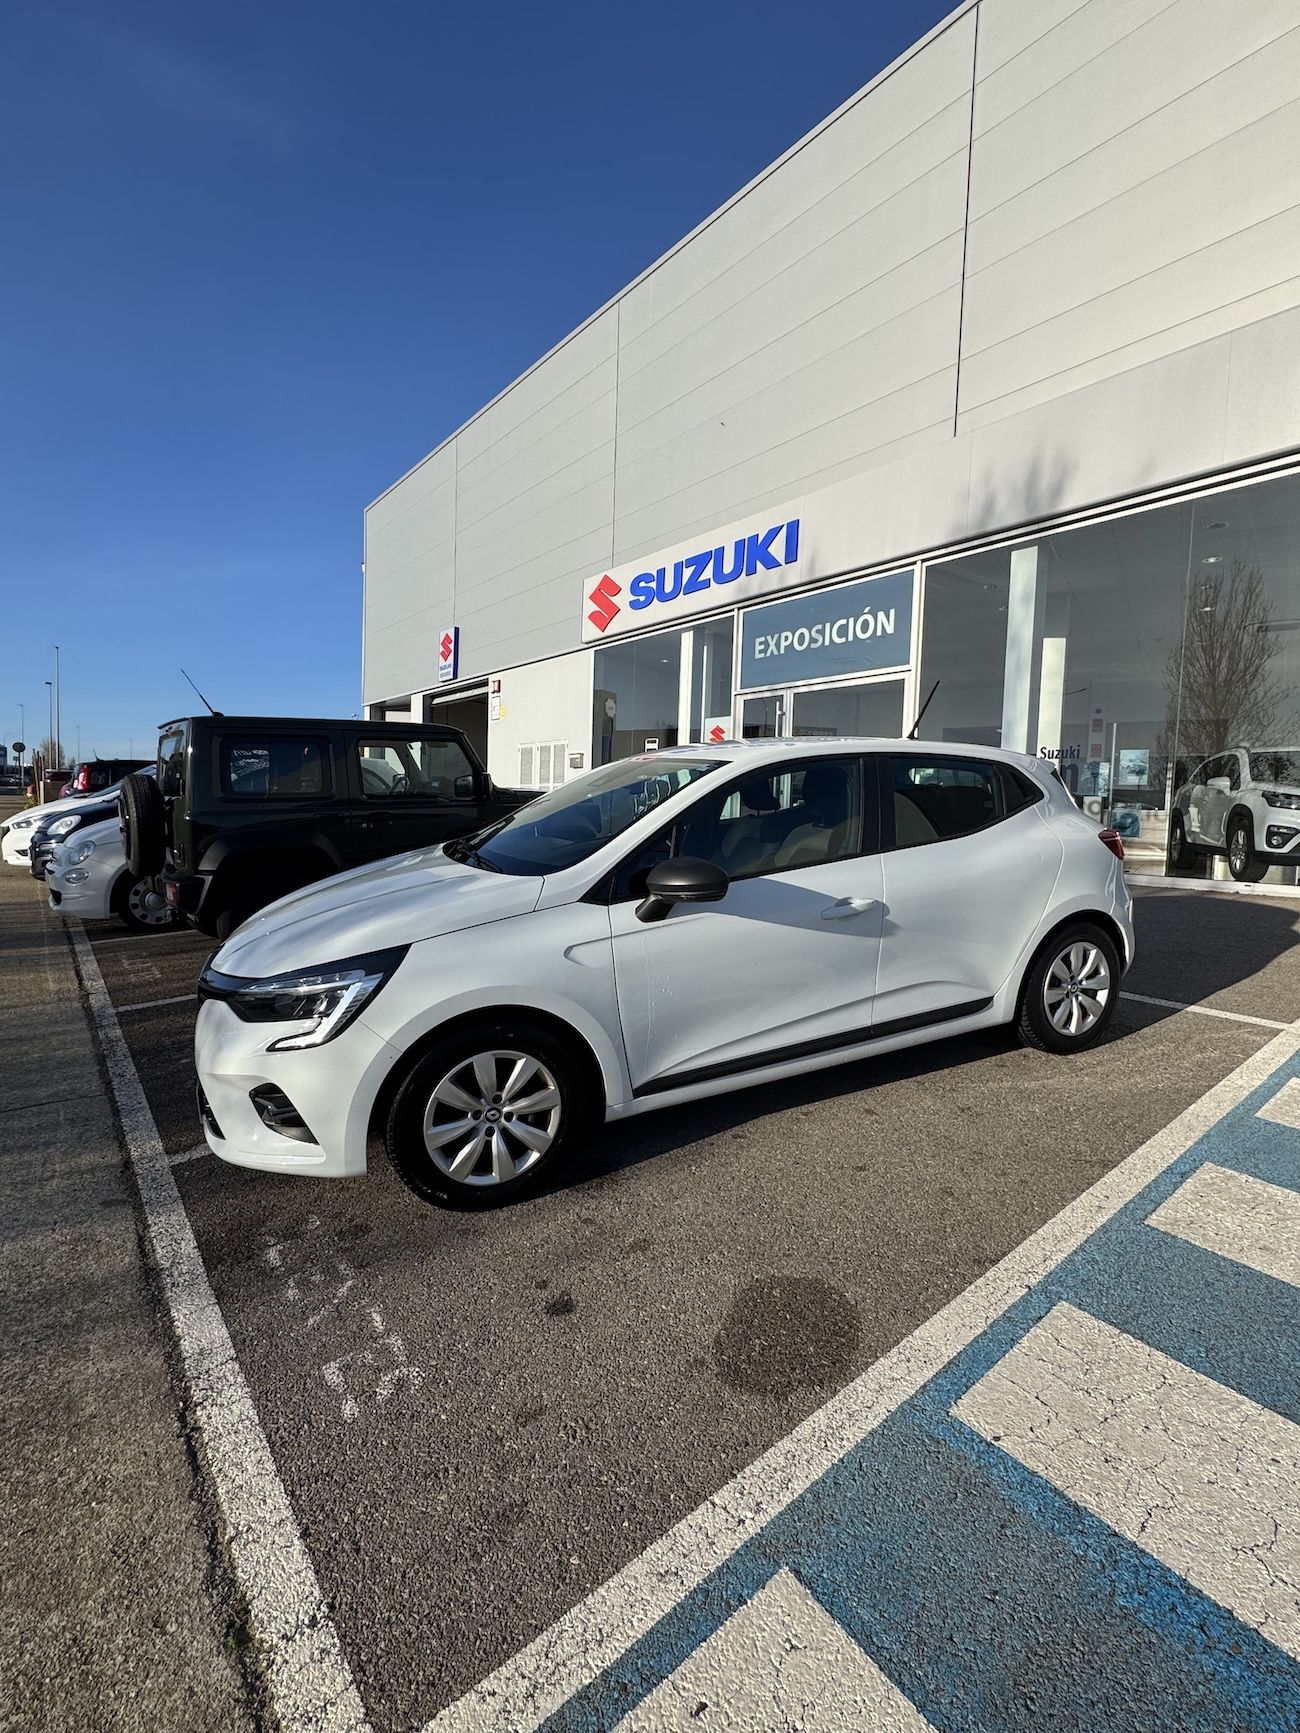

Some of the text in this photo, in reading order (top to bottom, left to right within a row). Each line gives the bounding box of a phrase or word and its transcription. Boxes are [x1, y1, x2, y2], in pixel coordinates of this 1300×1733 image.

[629, 519, 800, 610] SUZUKI
[754, 607, 896, 660] EXPOSICIÓN
[1040, 745, 1080, 759] Suzuki
